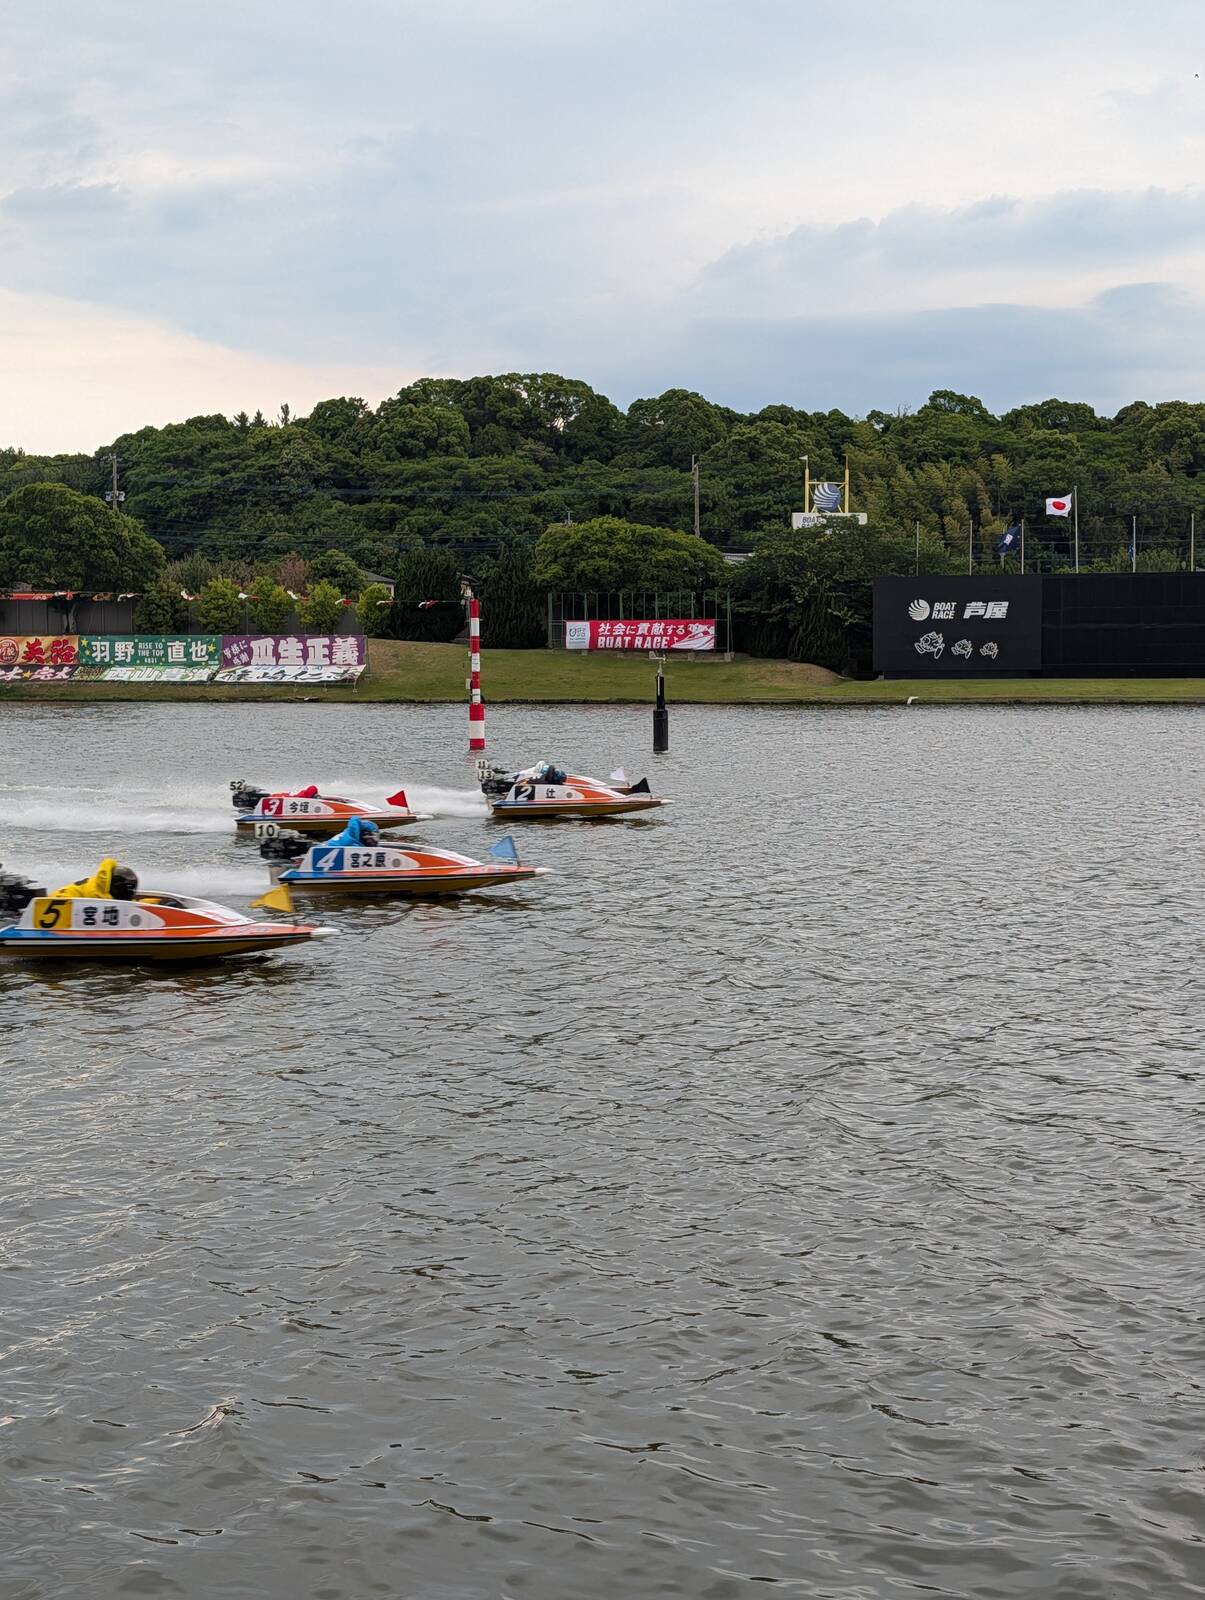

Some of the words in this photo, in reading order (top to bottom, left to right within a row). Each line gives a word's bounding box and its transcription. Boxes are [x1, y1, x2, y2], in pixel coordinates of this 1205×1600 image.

[934, 602, 957, 611] BOAT
[963, 601, 1010, 620] 芦屋
[931, 610, 956, 620] RACE
[597, 622, 685, 635] 社会に貢献する
[138, 642, 154, 650] RISE
[154, 642, 164, 650] TO
[597, 636, 631, 649] BOAT
[634, 636, 670, 649] RACE
[91, 641, 134, 663] 羽野
[138, 649, 151, 657] THE
[152, 649, 165, 657] TOP
[167, 640, 209, 663] 直也
[250, 636, 360, 665] 瓜生正義
[480, 770, 492, 779] 13
[229, 780, 242, 791] 52
[517, 786, 532, 801] 2
[545, 788, 556, 799] 辻
[263, 798, 280, 816] 3
[289, 801, 310, 814] 今垣
[257, 824, 275, 837] 10
[315, 848, 340, 872] 4
[350, 852, 387, 868] 宮之原
[39, 899, 68, 929] 5
